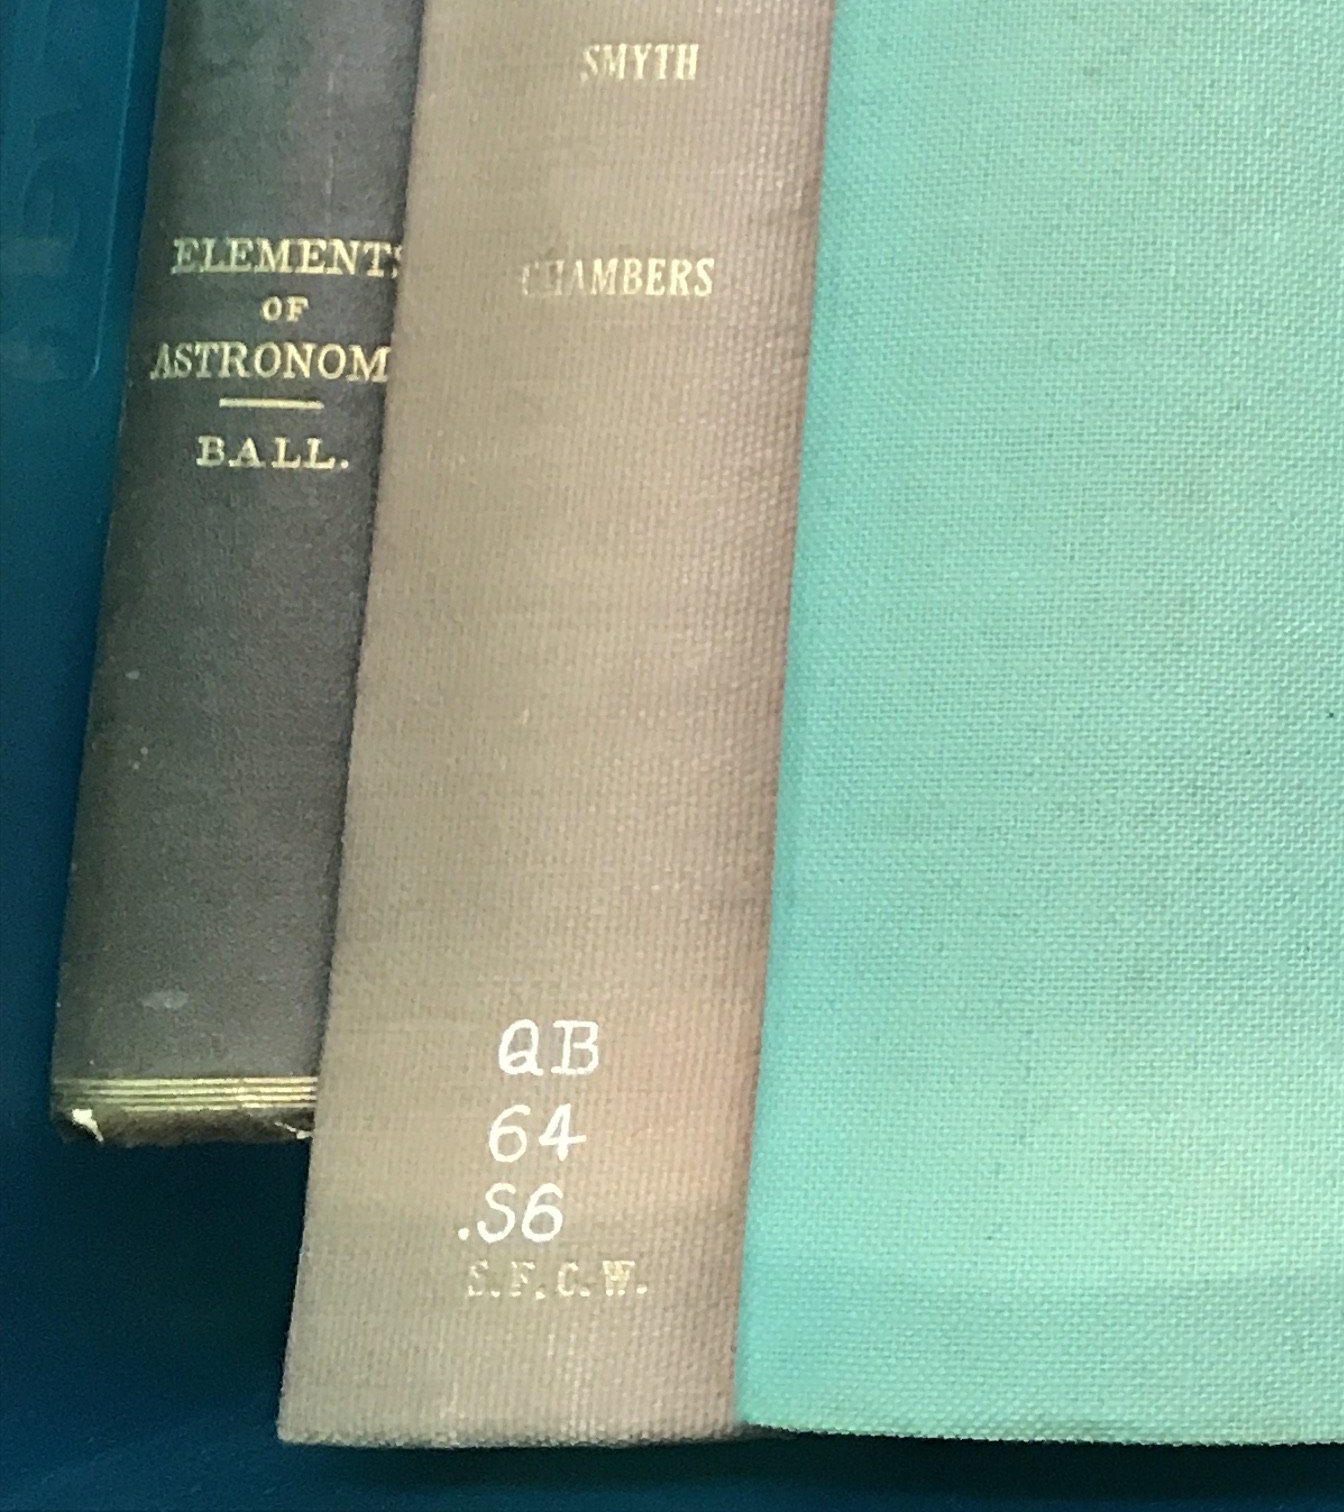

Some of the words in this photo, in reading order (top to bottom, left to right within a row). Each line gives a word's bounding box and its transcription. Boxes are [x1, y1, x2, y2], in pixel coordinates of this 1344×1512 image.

[579, 43, 700, 82] SMYTH
[260, 295, 310, 322] OF
[196, 435, 350, 470] BALL.
[497, 1018, 600, 1077] QB
[487, 1103, 588, 1163] 64
